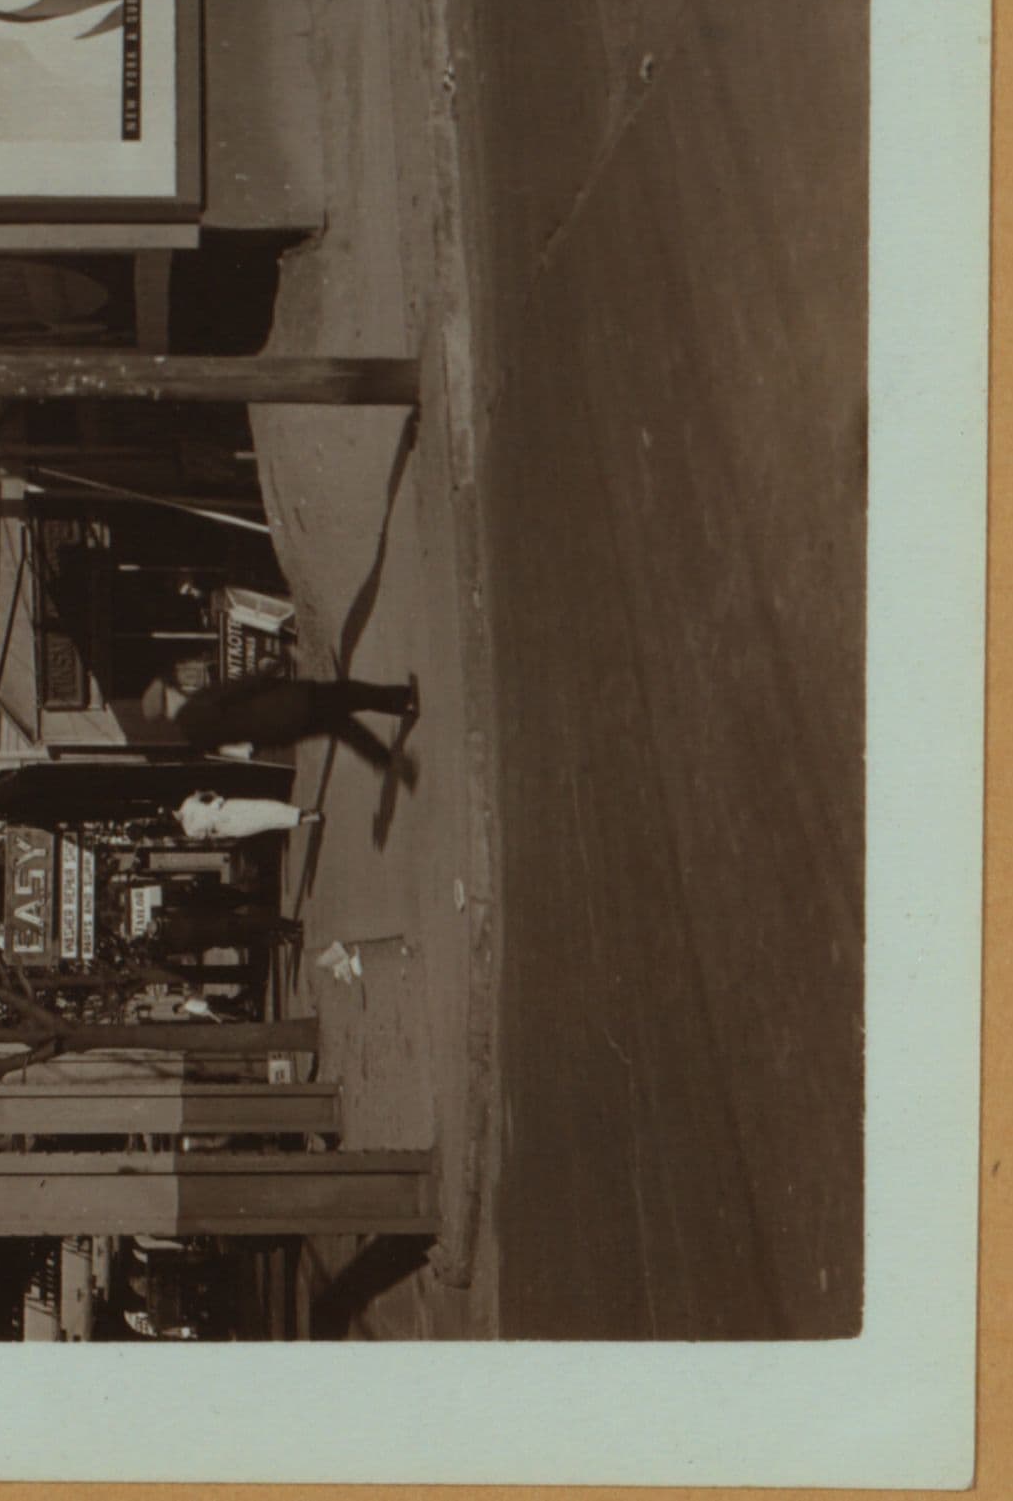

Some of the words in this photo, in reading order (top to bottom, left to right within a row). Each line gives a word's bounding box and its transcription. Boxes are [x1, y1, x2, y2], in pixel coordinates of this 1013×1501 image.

[126, 52, 138, 86] YORK
[125, 100, 138, 131] NEW
[12, 836, 46, 953] EASY
